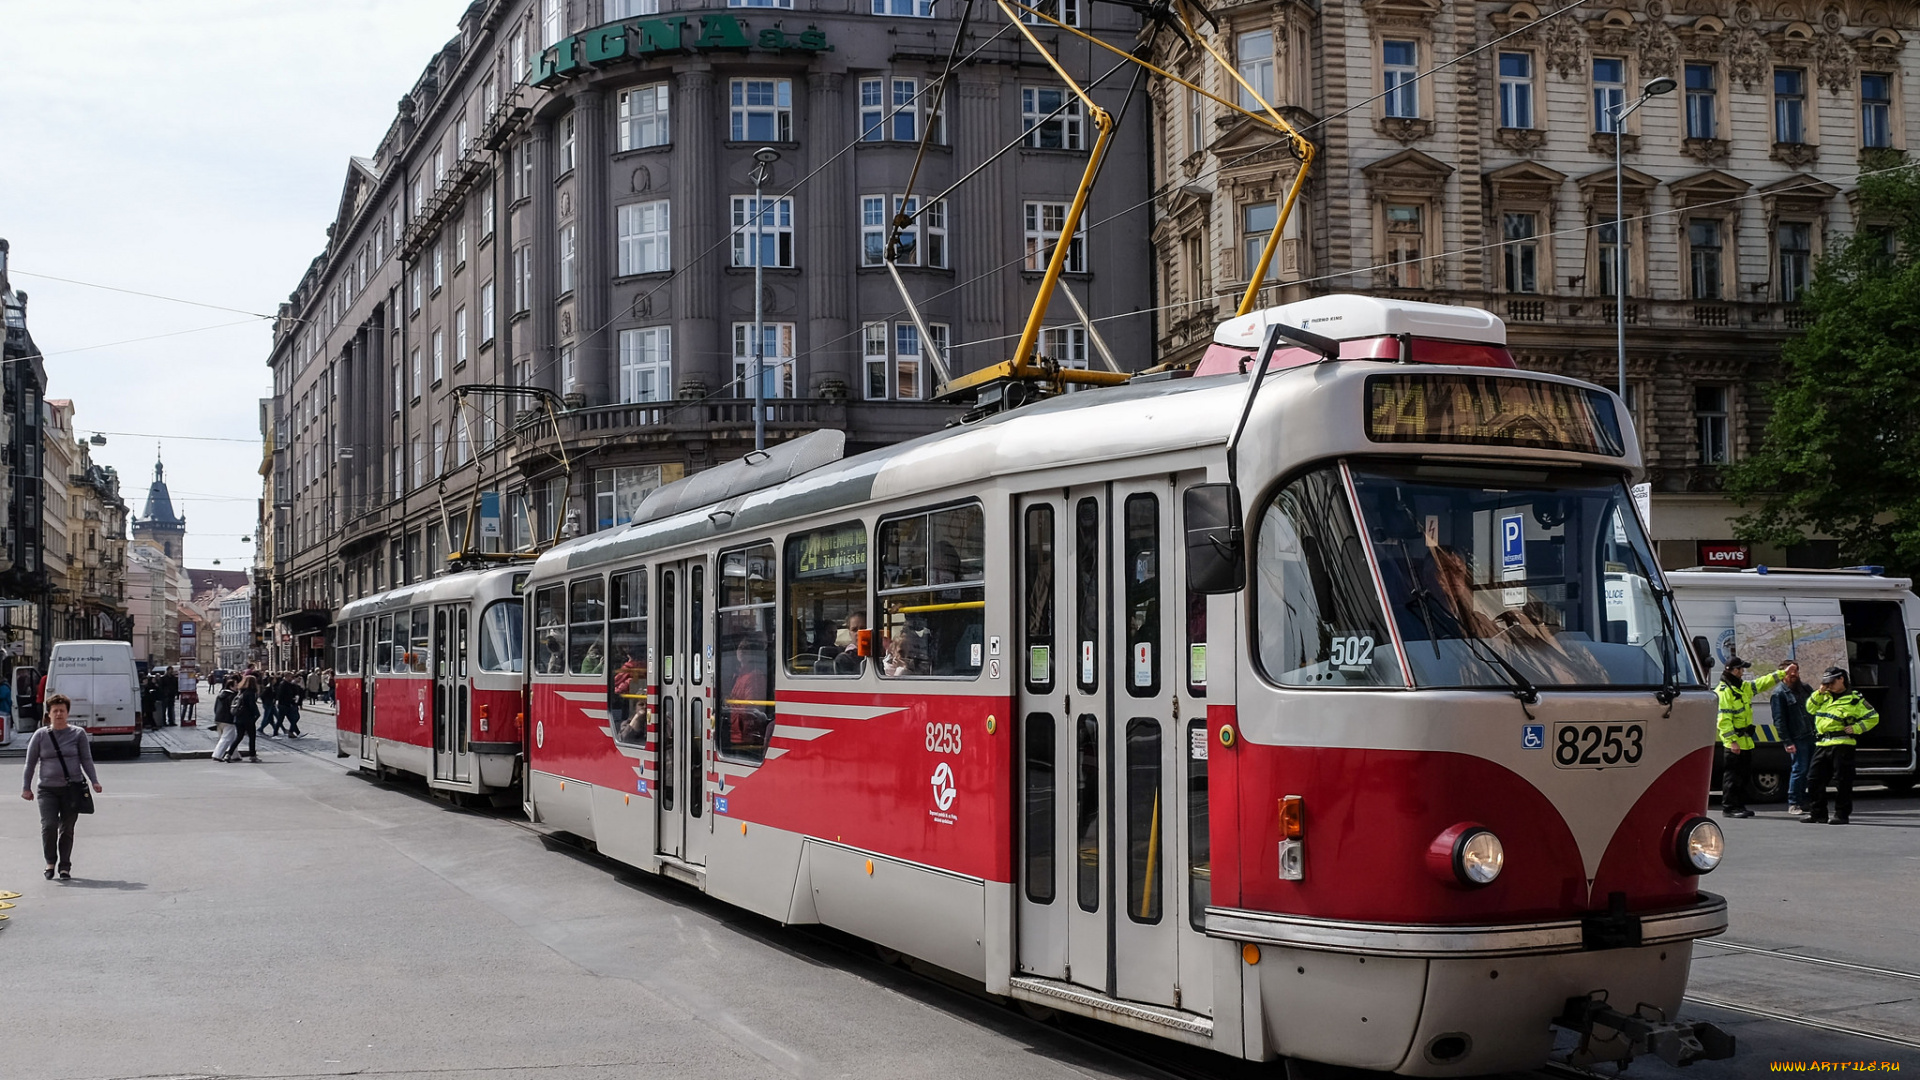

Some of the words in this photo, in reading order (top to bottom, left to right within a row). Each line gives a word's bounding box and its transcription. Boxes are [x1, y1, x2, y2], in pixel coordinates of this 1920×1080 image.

[528, 14, 751, 87] LIGNA
[1372, 382, 1426, 435] 24
[1506, 522, 1519, 552] P
[1330, 635, 1375, 666] 502
[925, 721, 962, 755] 8253
[1556, 724, 1644, 766] 8253
